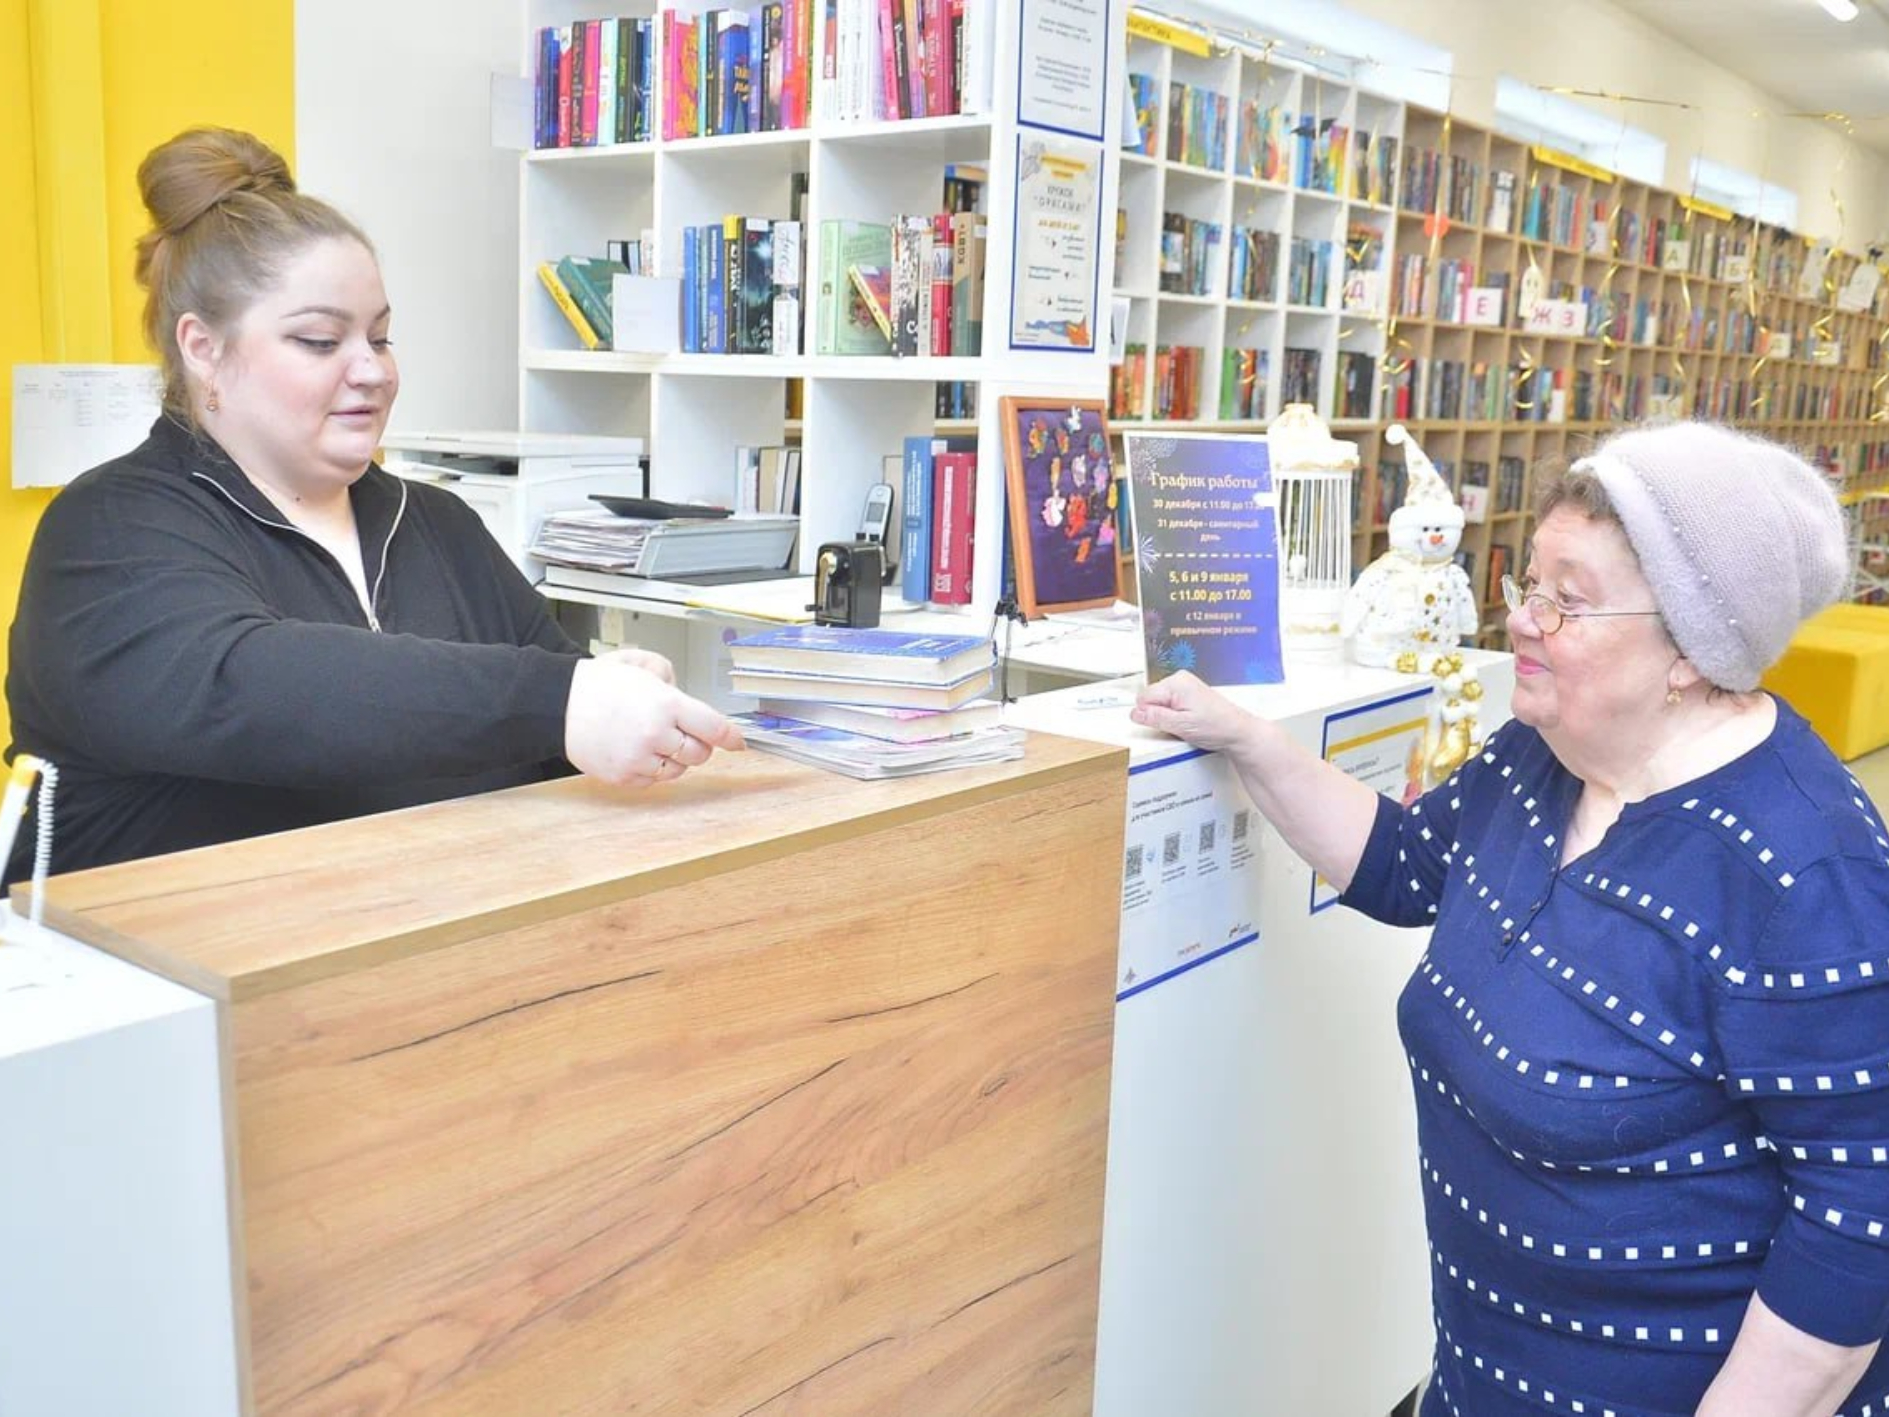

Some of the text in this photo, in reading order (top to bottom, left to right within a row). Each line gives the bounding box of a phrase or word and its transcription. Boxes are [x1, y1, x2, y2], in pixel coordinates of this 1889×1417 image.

[1476, 296, 1488, 316] Е
[1532, 305, 1575, 327] Ж З
[1150, 470, 1258, 491] График работы
[1165, 499, 1201, 510] декабря
[1232, 501, 1243, 511] до
[1158, 519, 1167, 528] 31
[1169, 519, 1203, 531] декабря
[1209, 519, 1259, 531] санитарный
[1200, 533, 1221, 543] день
[1169, 571, 1249, 584] 5, 6 и 9 января
[1170, 589, 1252, 603] с 11.00 до 17.00
[1186, 613, 1191, 621] с
[1193, 611, 1202, 621] 12
[1203, 612, 1234, 622] января
[1170, 626, 1258, 638] привычном режиме
